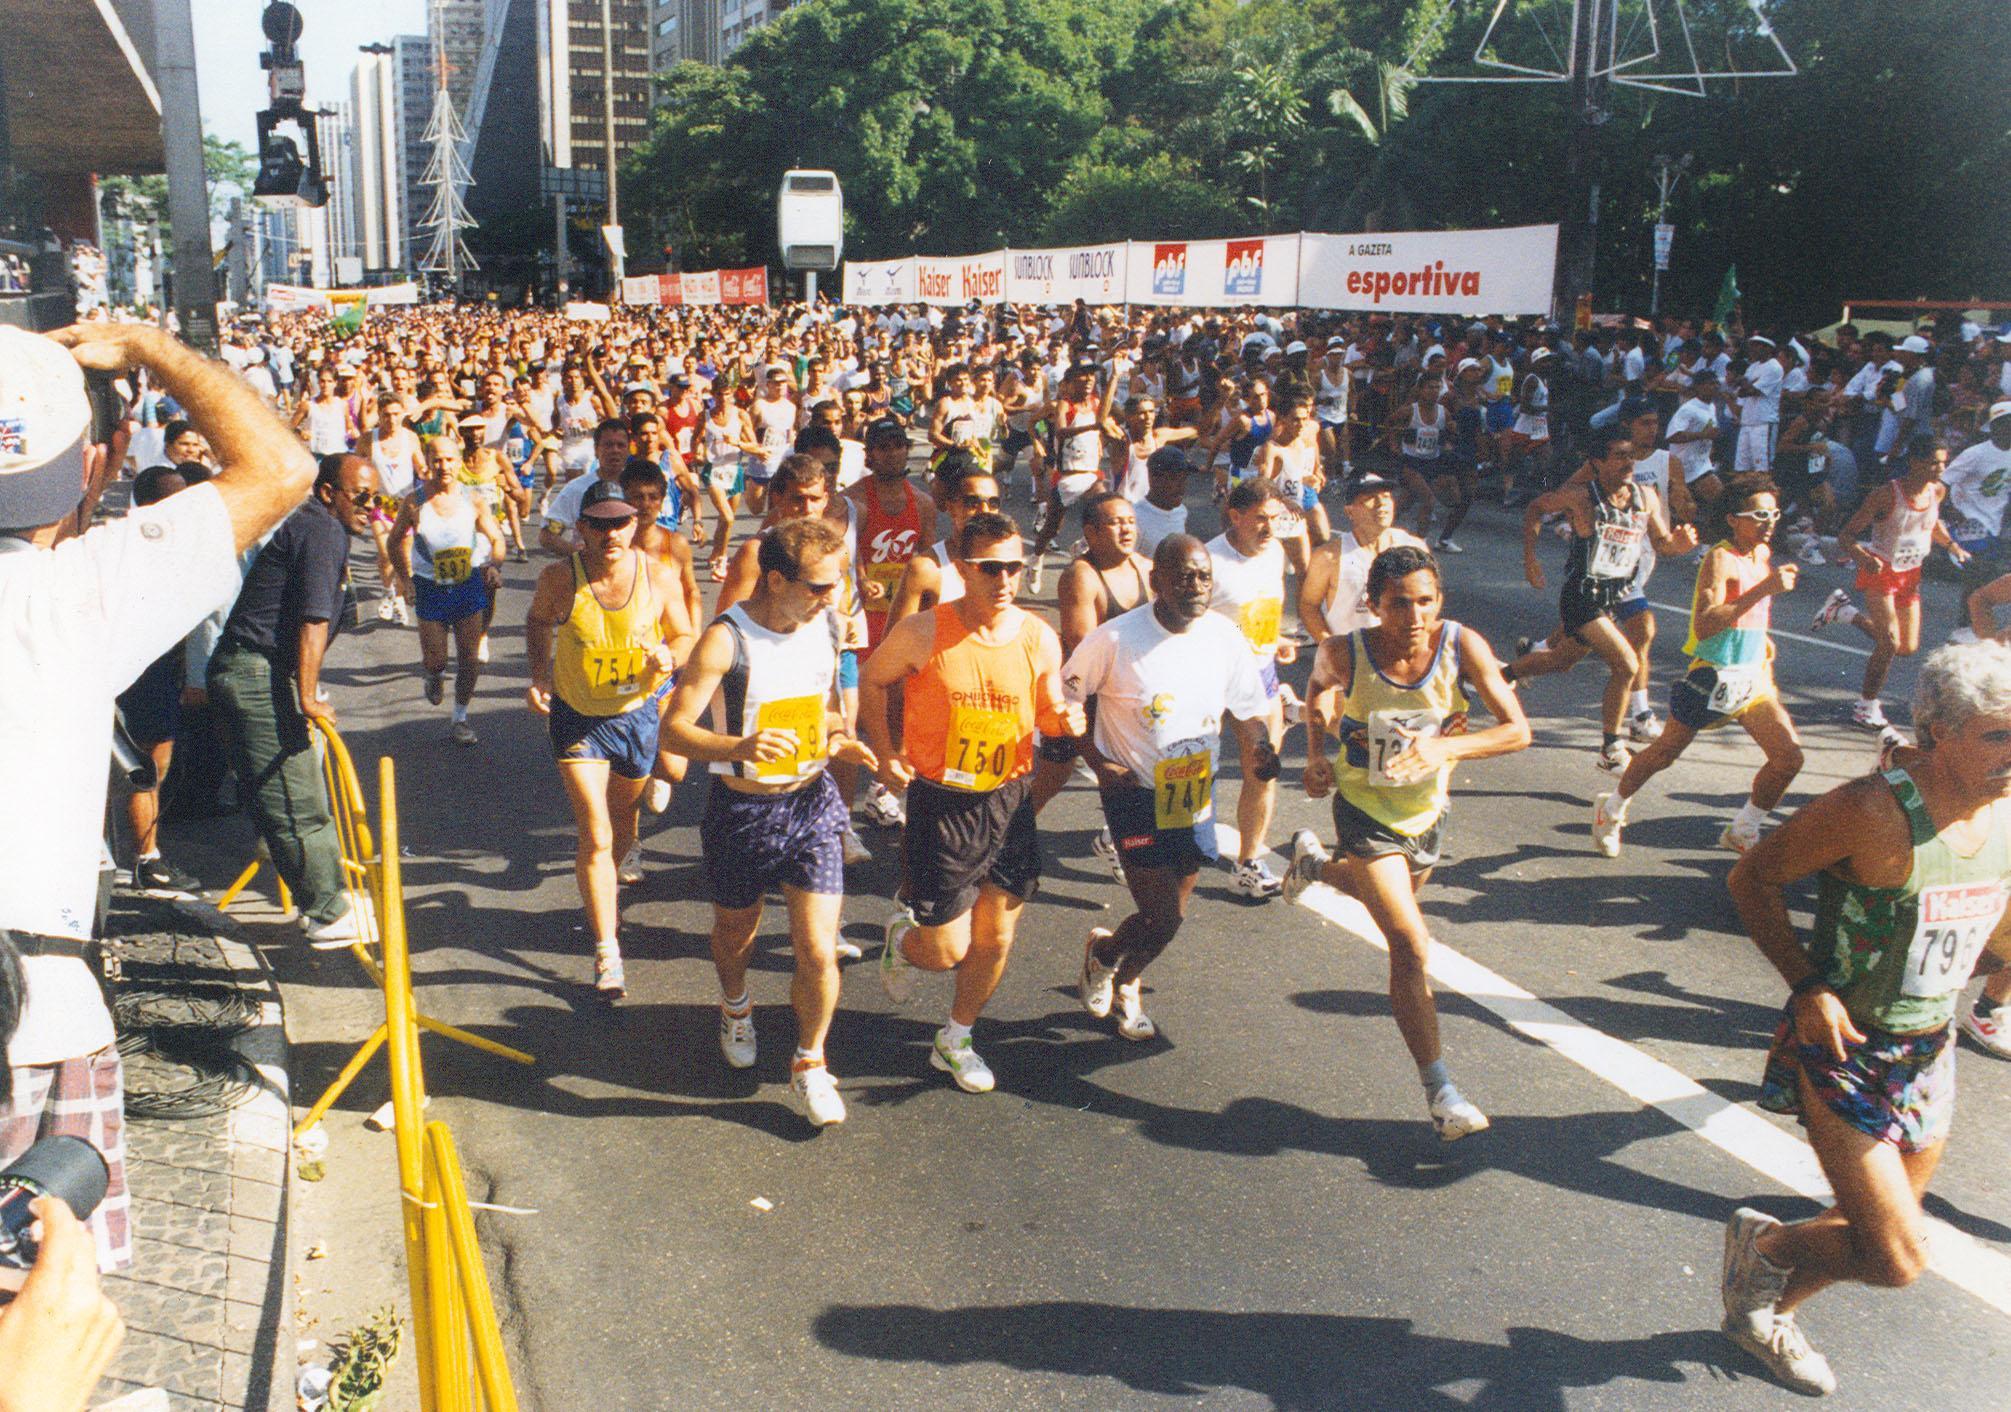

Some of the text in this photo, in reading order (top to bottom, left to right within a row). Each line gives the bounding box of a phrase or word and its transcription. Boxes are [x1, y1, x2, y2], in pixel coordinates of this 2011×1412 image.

[1227, 249, 1262, 286] pbf
[1349, 244, 1392, 256] A GAZETA
[919, 265, 952, 297] Kaiser
[962, 263, 1002, 298] Kaiser
[1155, 252, 1185, 285] pbf
[1347, 260, 1481, 304] esportiva
[593, 656, 635, 688] 754
[957, 738, 1006, 777] 750
[1165, 777, 1207, 815] 747
